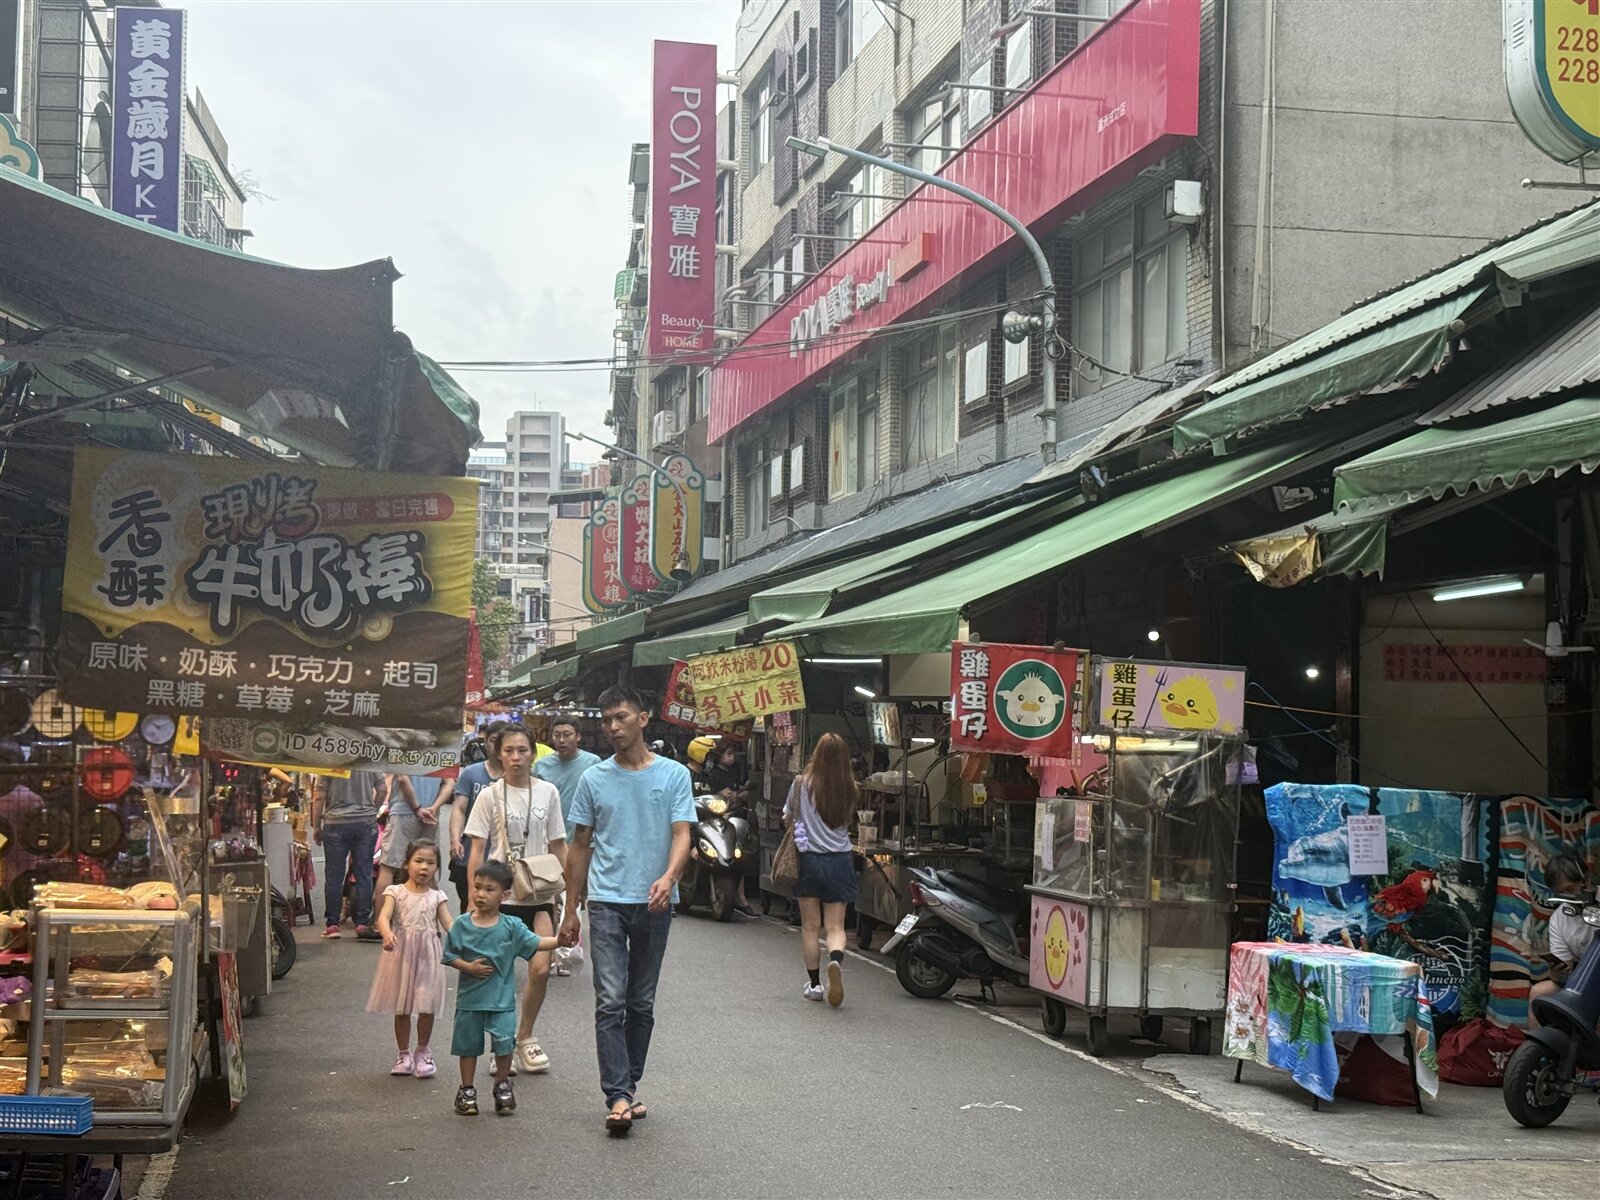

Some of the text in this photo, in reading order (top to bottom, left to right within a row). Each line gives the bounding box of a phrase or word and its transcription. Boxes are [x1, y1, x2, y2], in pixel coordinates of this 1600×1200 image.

[1557, 26, 1599, 53] 228
[1558, 57, 1600, 84] 228
[127, 18, 172, 180] 黃金歲月
[669, 85, 701, 194] POYA
[668, 204, 701, 279] 寶雅
[661, 313, 704, 331] Beauty
[664, 336, 700, 348] HOME
[203, 474, 321, 542] 現烤
[98, 489, 171, 607] 香酥
[192, 532, 418, 628] 牛奶棒
[760, 643, 791, 672] 20
[701, 681, 802, 720] 各式小菜
[959, 649, 990, 740] 雞蛋仔
[1111, 663, 1137, 728] 雞蛋仔
[284, 733, 306, 751] ID
[311, 737, 385, 762] 4585hy
[387, 748, 457, 768] 歡迎加盟
